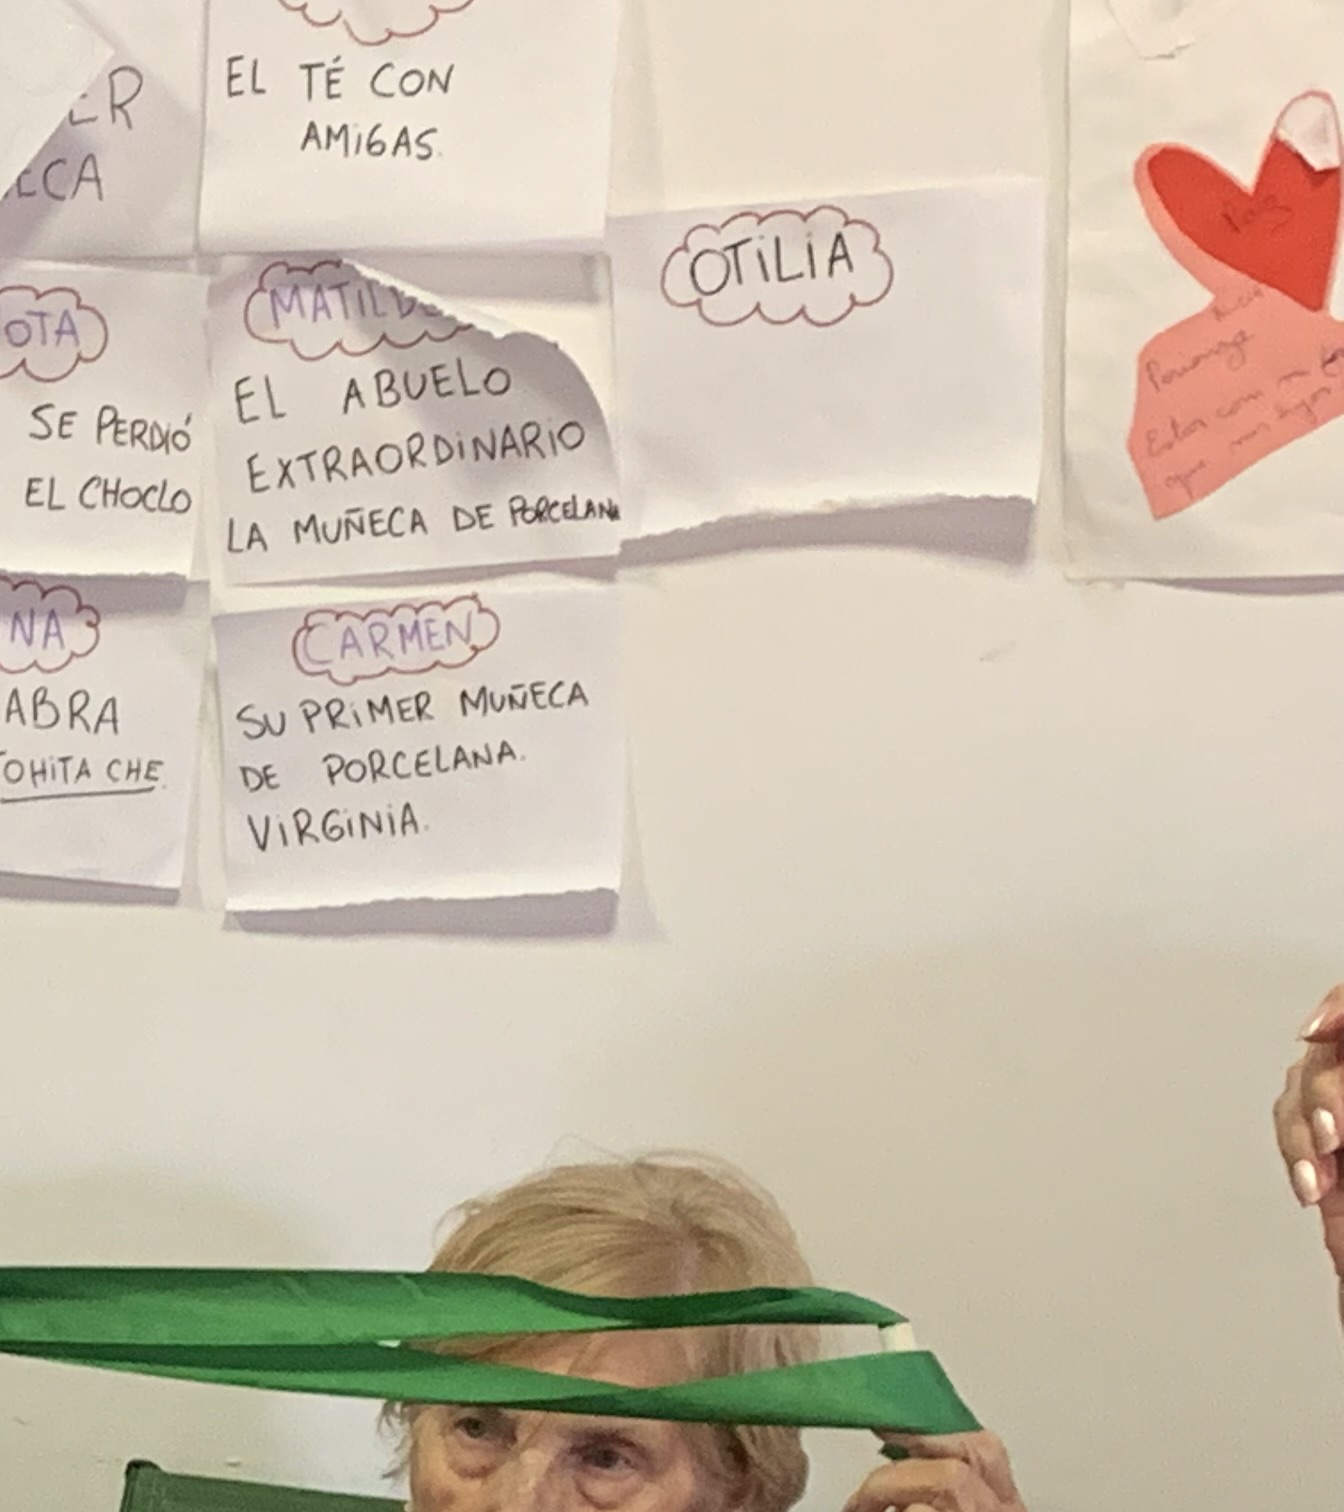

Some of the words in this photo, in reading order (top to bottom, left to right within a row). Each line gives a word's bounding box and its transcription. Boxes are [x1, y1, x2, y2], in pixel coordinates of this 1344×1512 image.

[225, 54, 267, 99] EL
[298, 54, 346, 102] TÉ
[369, 61, 455, 99] CON
[688, 230, 855, 297] OTILIA
[269, 279, 442, 329] MATILD
[233, 374, 287, 425] EL
[342, 356, 512, 416] ABUELO
[28, 402, 79, 441] SE
[95, 403, 193, 456] PERDIÓ
[245, 420, 586, 495] EXTRAORDINARIO
[24, 475, 67, 512] EL
[77, 474, 193, 516] CHOCLO
[226, 517, 269, 554] LA
[292, 505, 429, 545] MUÑECA
[451, 503, 495, 533] DE
[303, 611, 473, 665] CARMEN
[235, 703, 287, 741] SU
[298, 690, 435, 735] PRIMER
[458, 679, 590, 718] MUÑECA
[238, 763, 281, 794] DE
